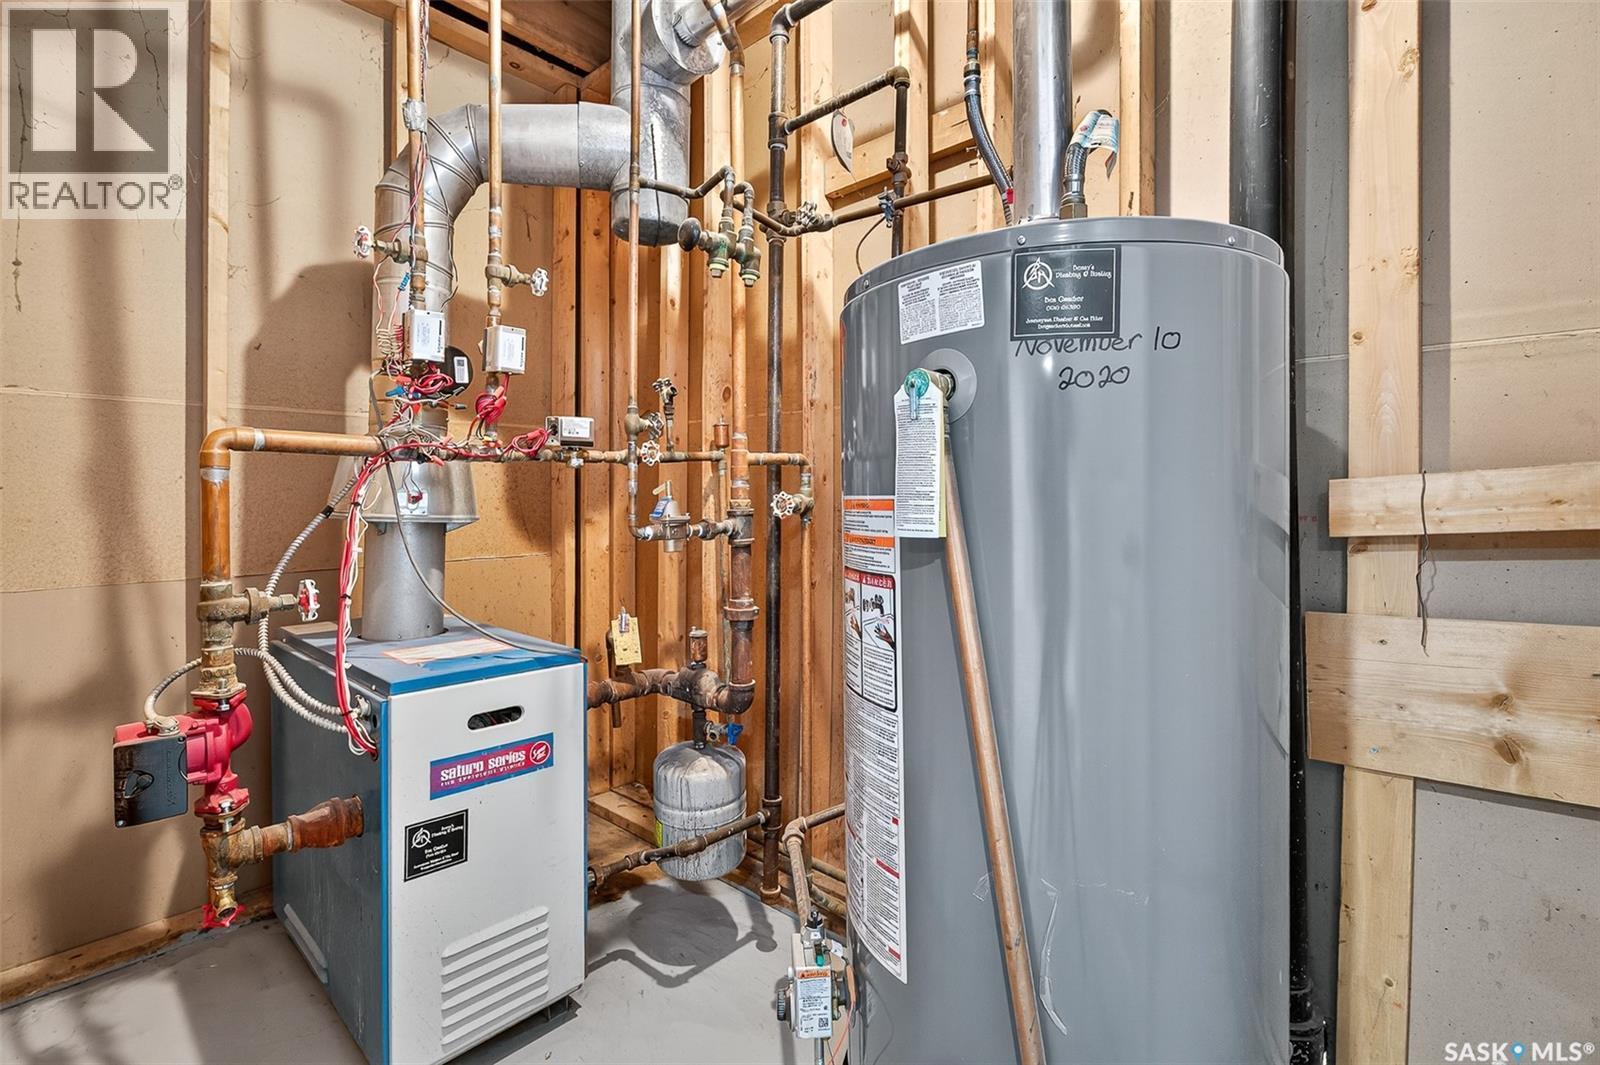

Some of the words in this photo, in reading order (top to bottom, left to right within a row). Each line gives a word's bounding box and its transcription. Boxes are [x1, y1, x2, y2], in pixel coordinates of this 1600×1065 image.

[1154, 326, 1181, 351] 10
[1059, 365, 1130, 391] 2020
[440, 760, 484, 781] saturn
